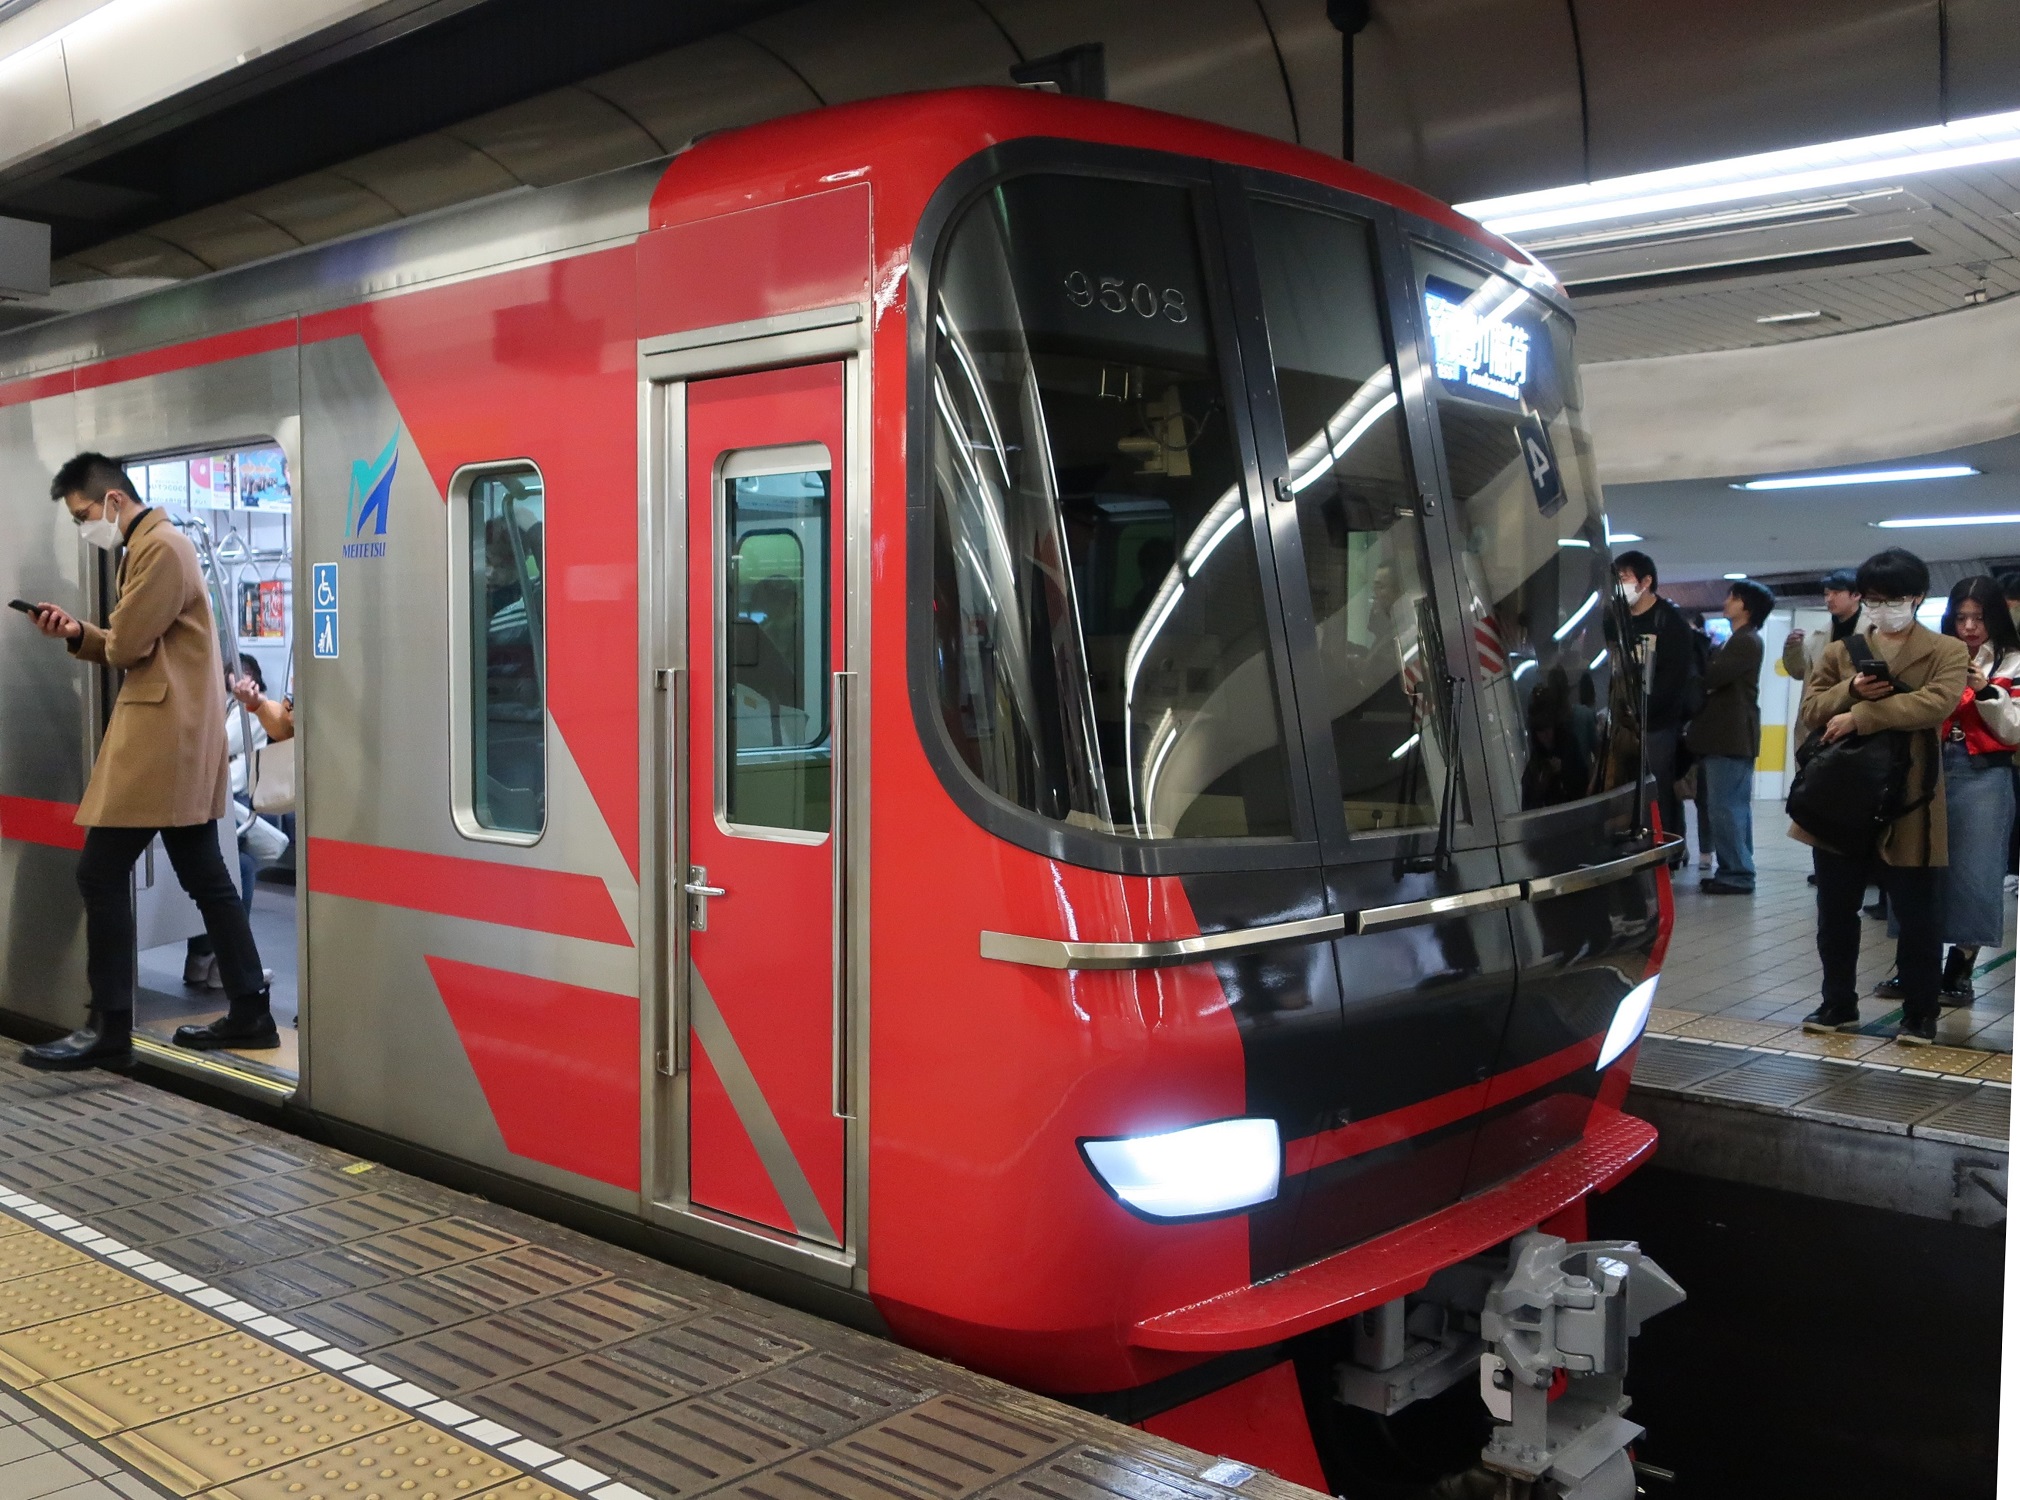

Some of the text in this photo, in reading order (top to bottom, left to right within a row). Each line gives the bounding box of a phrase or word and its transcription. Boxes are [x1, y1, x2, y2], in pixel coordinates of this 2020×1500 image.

[1064, 270, 1188, 323] 9508
[1526, 437, 1550, 489] 4
[342, 541, 387, 559] MEITETSU
